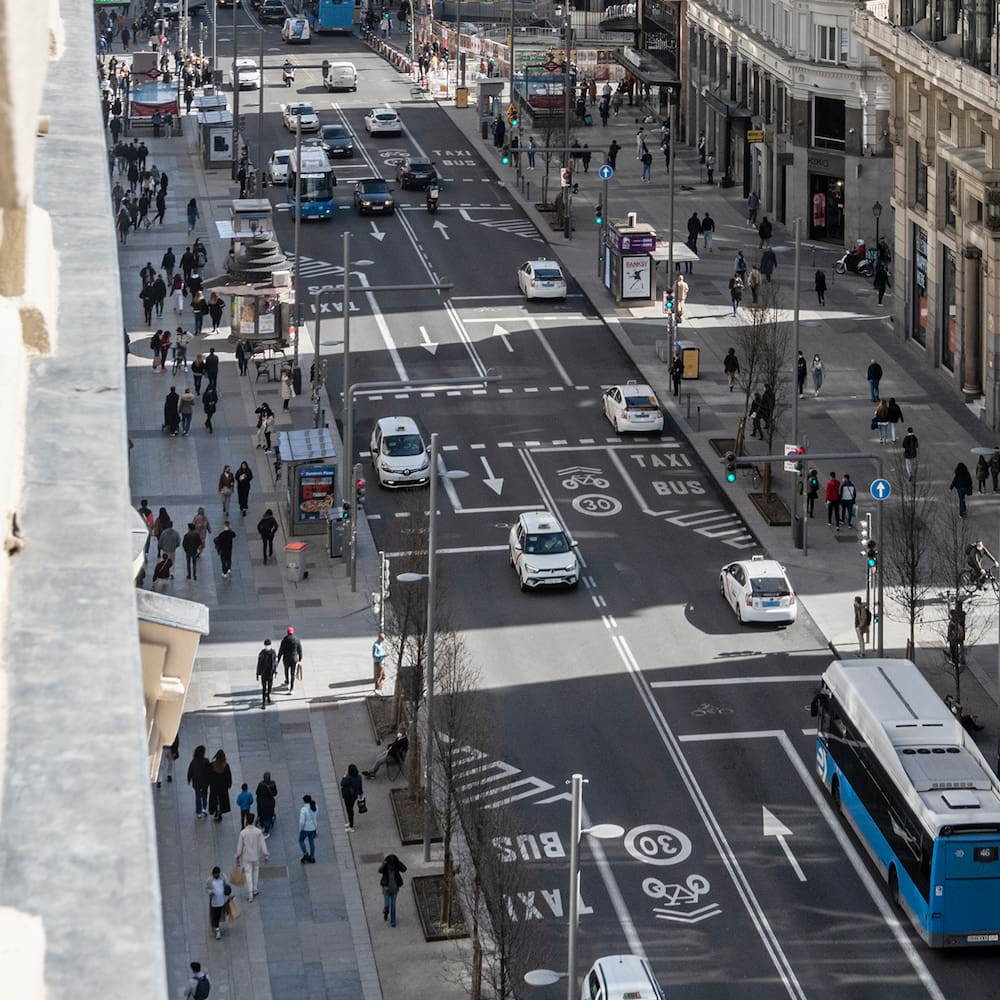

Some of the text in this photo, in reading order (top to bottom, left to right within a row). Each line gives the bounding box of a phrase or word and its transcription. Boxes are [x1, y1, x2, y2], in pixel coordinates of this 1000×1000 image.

[432, 149, 472, 157] TAXI
[630, 453, 692, 468] TAXI
[651, 480, 706, 496] BUS
[582, 499, 612, 512] 30
[492, 831, 566, 863] BUS
[639, 834, 678, 856] 30
[502, 888, 594, 923] TAXI
